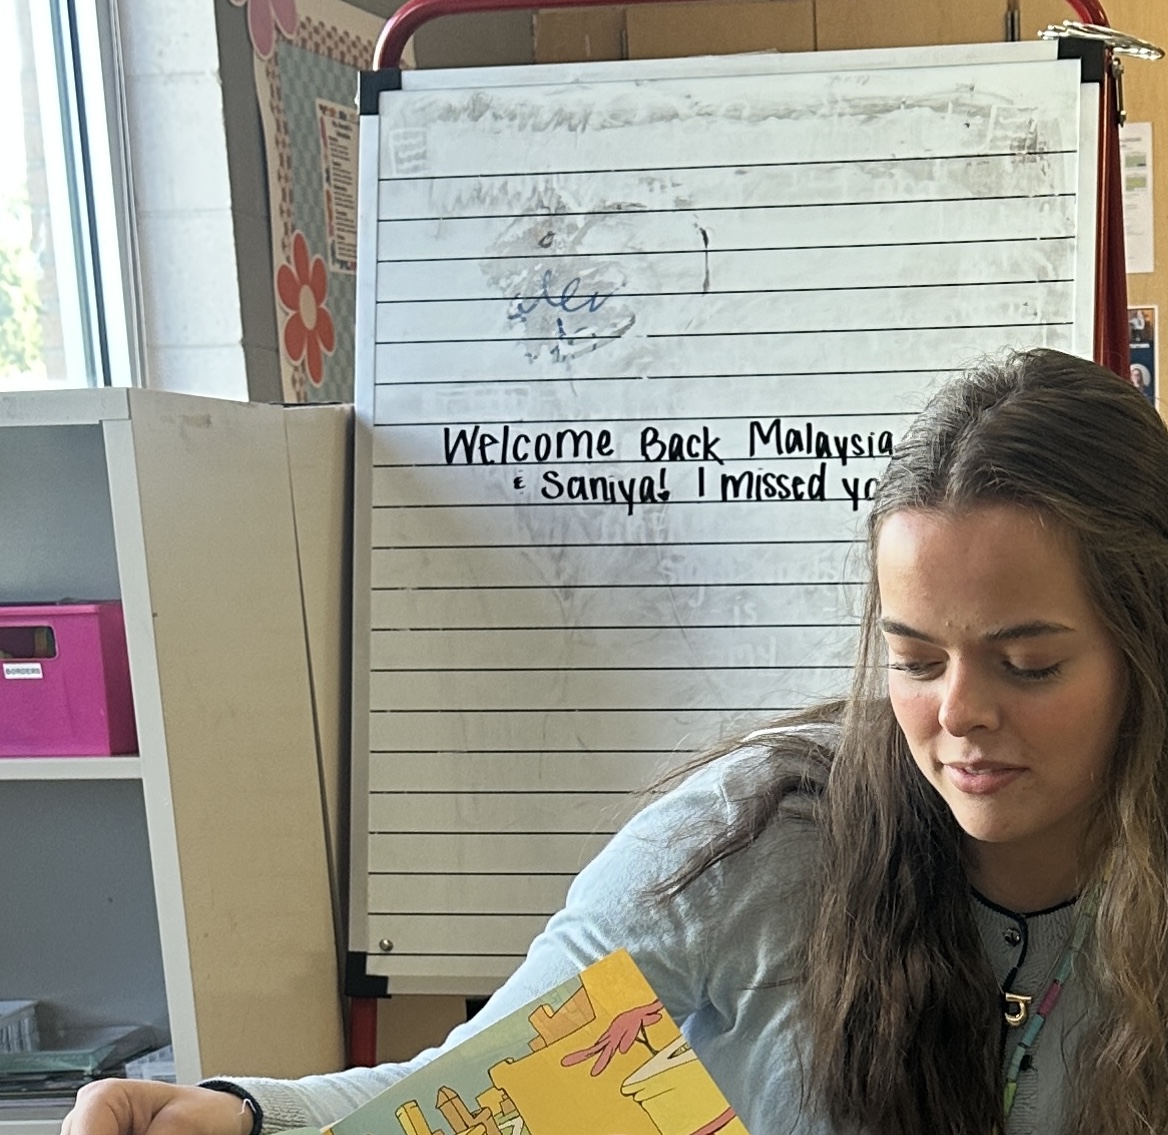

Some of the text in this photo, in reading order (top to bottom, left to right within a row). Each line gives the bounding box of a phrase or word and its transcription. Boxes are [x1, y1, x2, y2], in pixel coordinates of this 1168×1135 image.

[444, 419, 894, 466] Welcome Back Malaysia
[541, 468, 671, 515] Saniya!
[698, 467, 705, 498] I
[721, 462, 827, 502] missed
